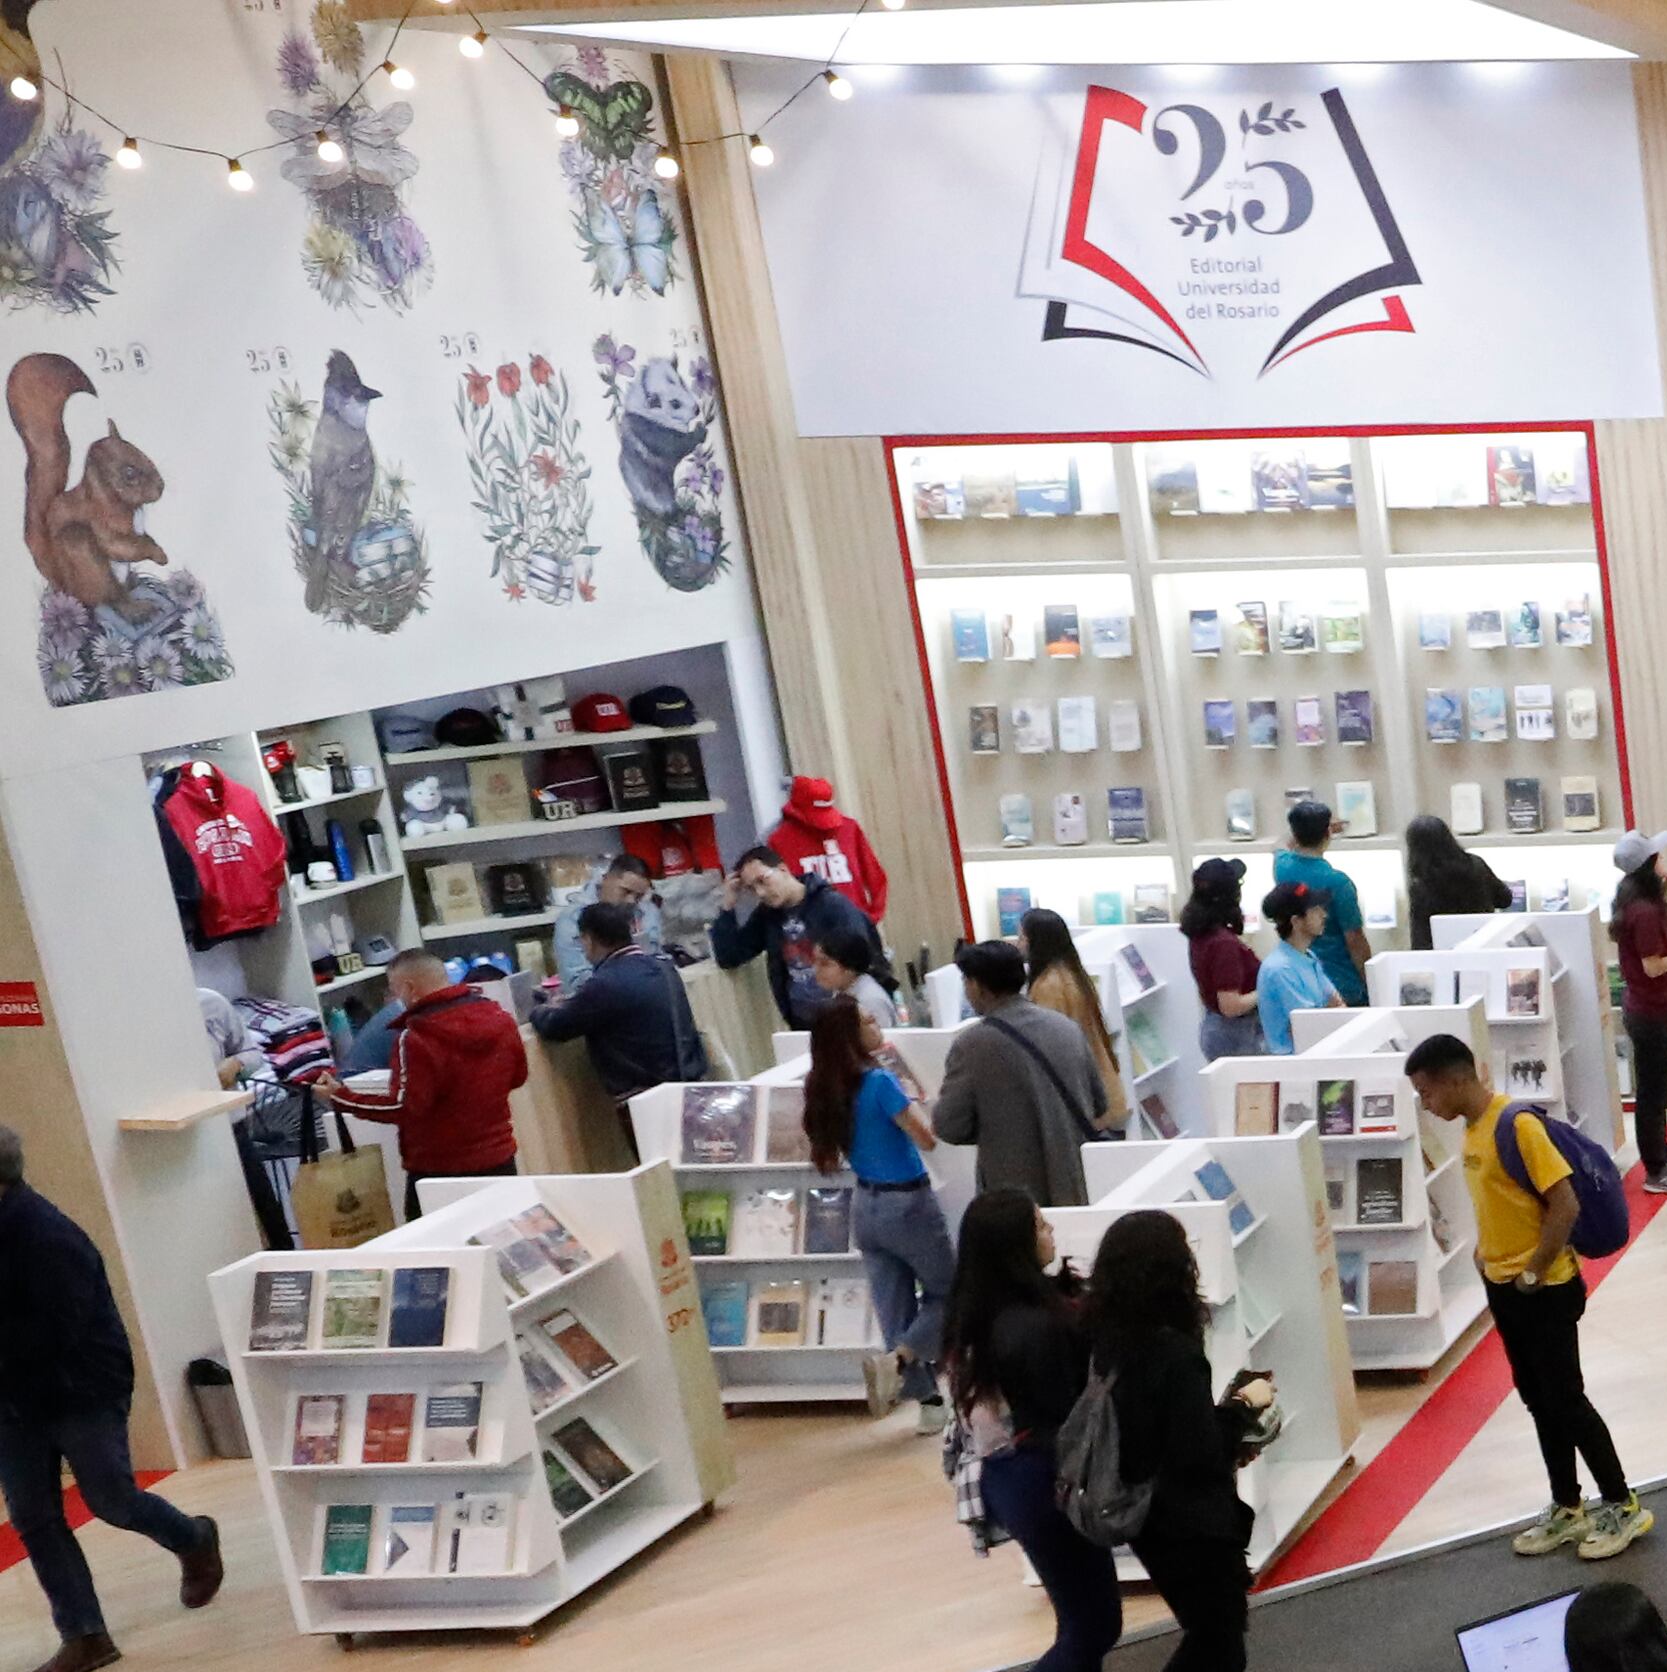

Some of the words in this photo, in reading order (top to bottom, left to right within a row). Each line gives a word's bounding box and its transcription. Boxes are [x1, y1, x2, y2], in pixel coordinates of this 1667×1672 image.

[1153, 104, 1313, 235] 25
[1190, 255, 1262, 275] Editorial
[1177, 278, 1280, 297] Universidad
[1185, 303, 1212, 320] del
[1217, 303, 1280, 319] Rosario
